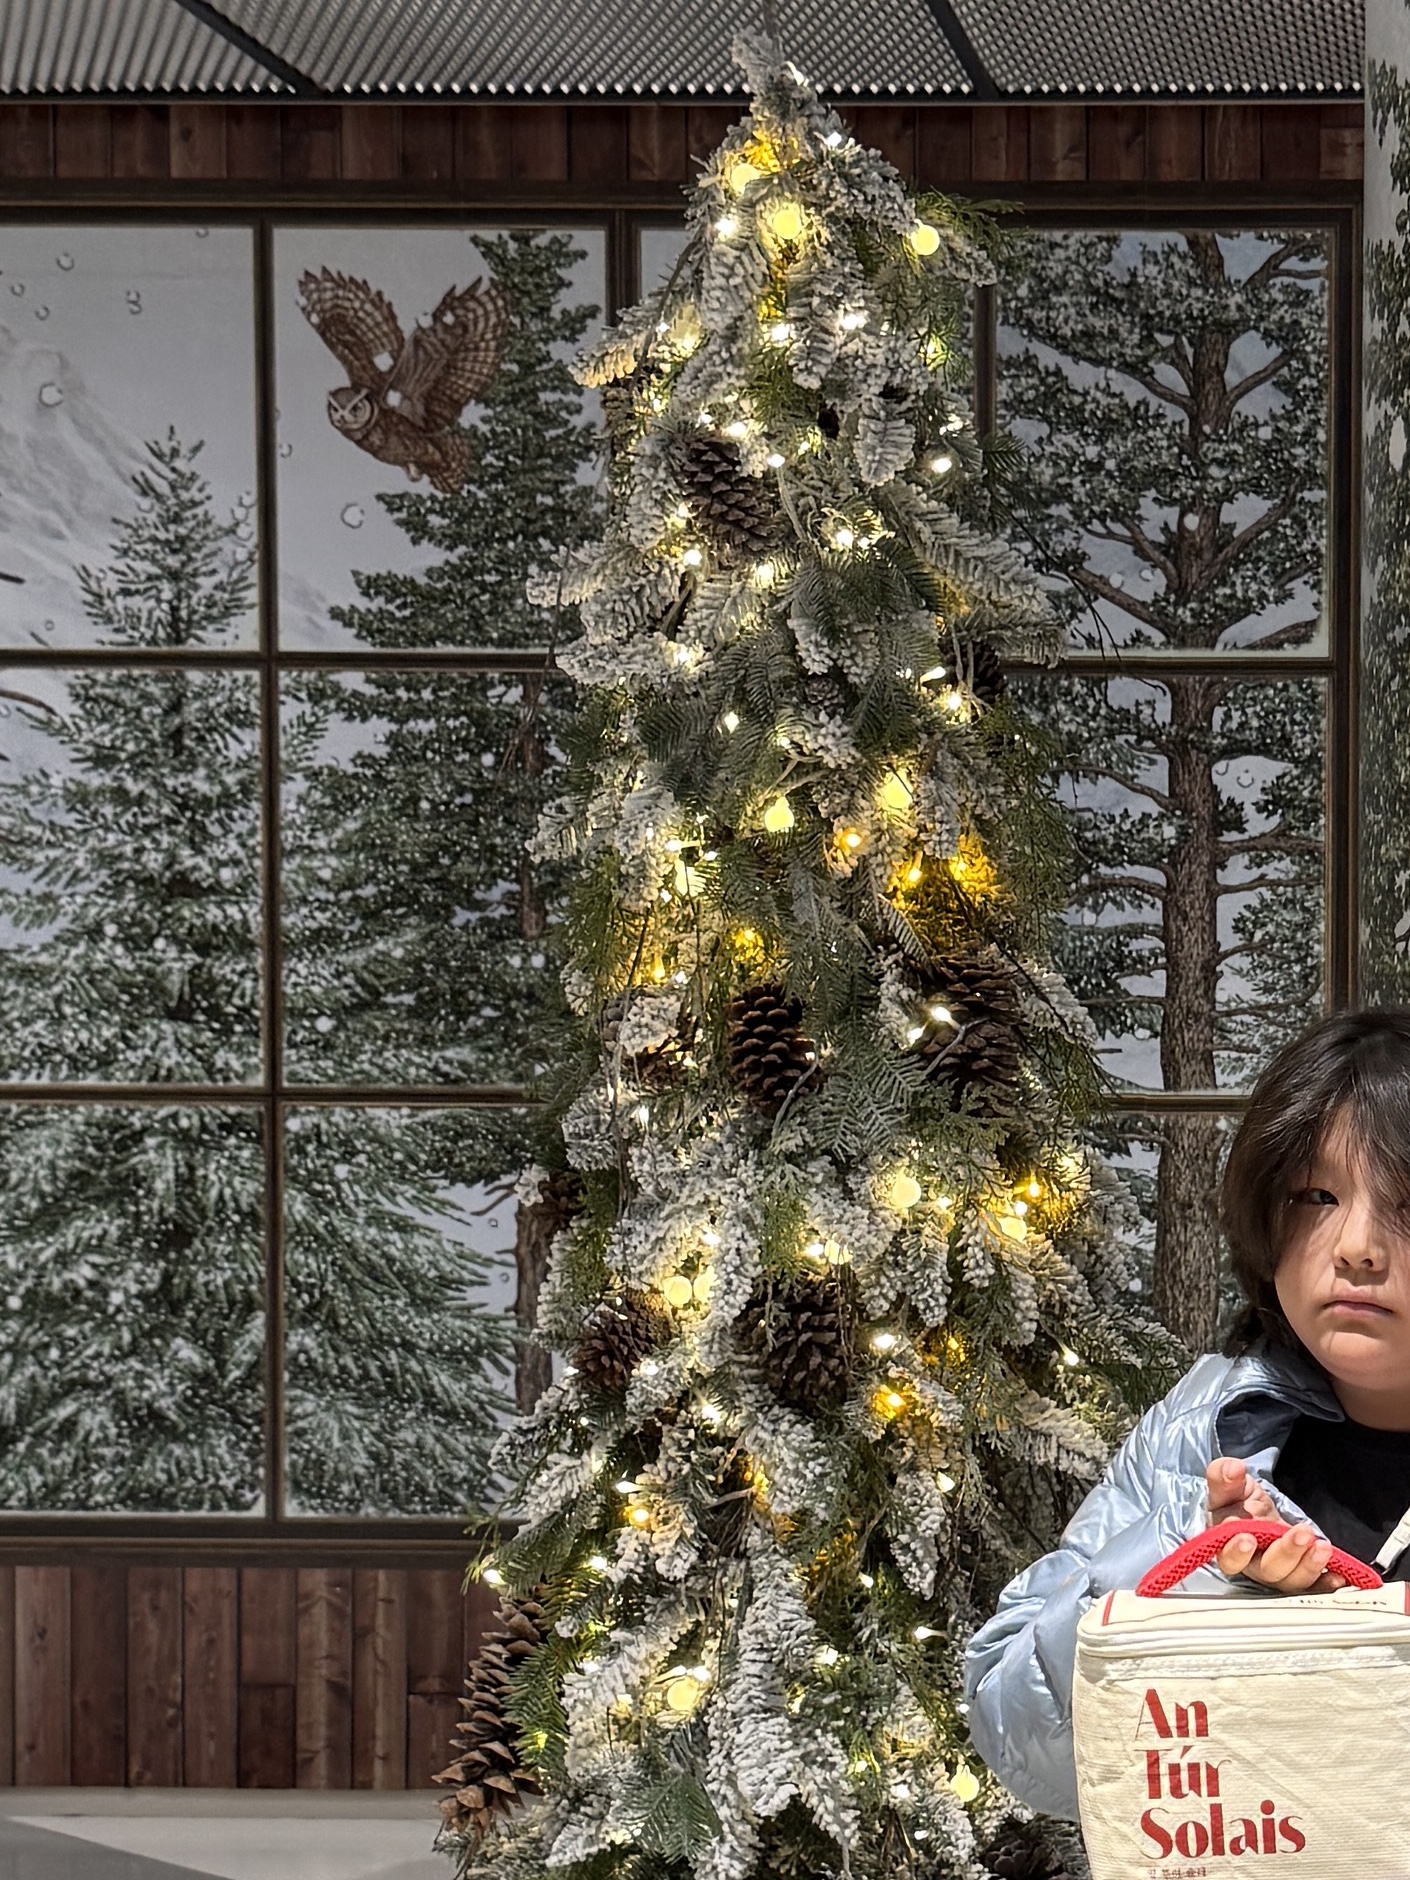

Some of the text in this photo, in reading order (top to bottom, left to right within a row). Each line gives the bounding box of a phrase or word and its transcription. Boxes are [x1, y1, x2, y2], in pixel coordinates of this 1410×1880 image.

[1134, 1688, 1210, 1740] An
[1134, 1745, 1232, 1800] Túr
[1140, 1799, 1307, 1860] Solais
